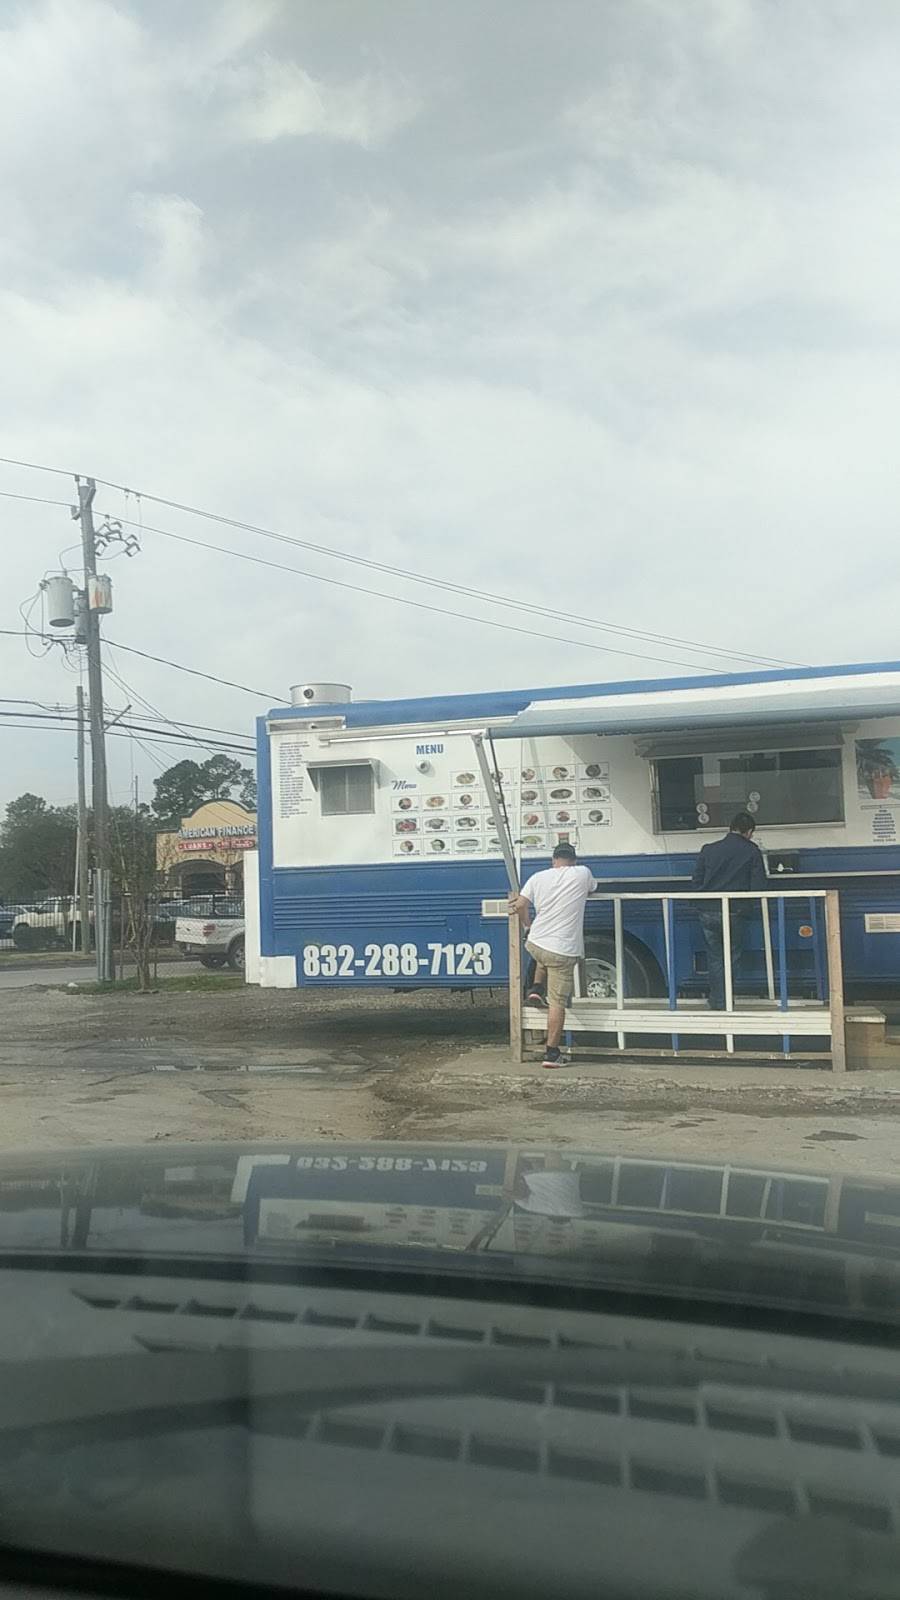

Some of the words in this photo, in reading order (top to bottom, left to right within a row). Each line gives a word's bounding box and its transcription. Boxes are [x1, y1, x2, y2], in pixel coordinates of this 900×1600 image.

[416, 744, 444, 755] MENU
[177, 827, 215, 838] AMERICAN
[217, 825, 254, 837] FINANCE
[303, 942, 492, 976] 832-288-7123
